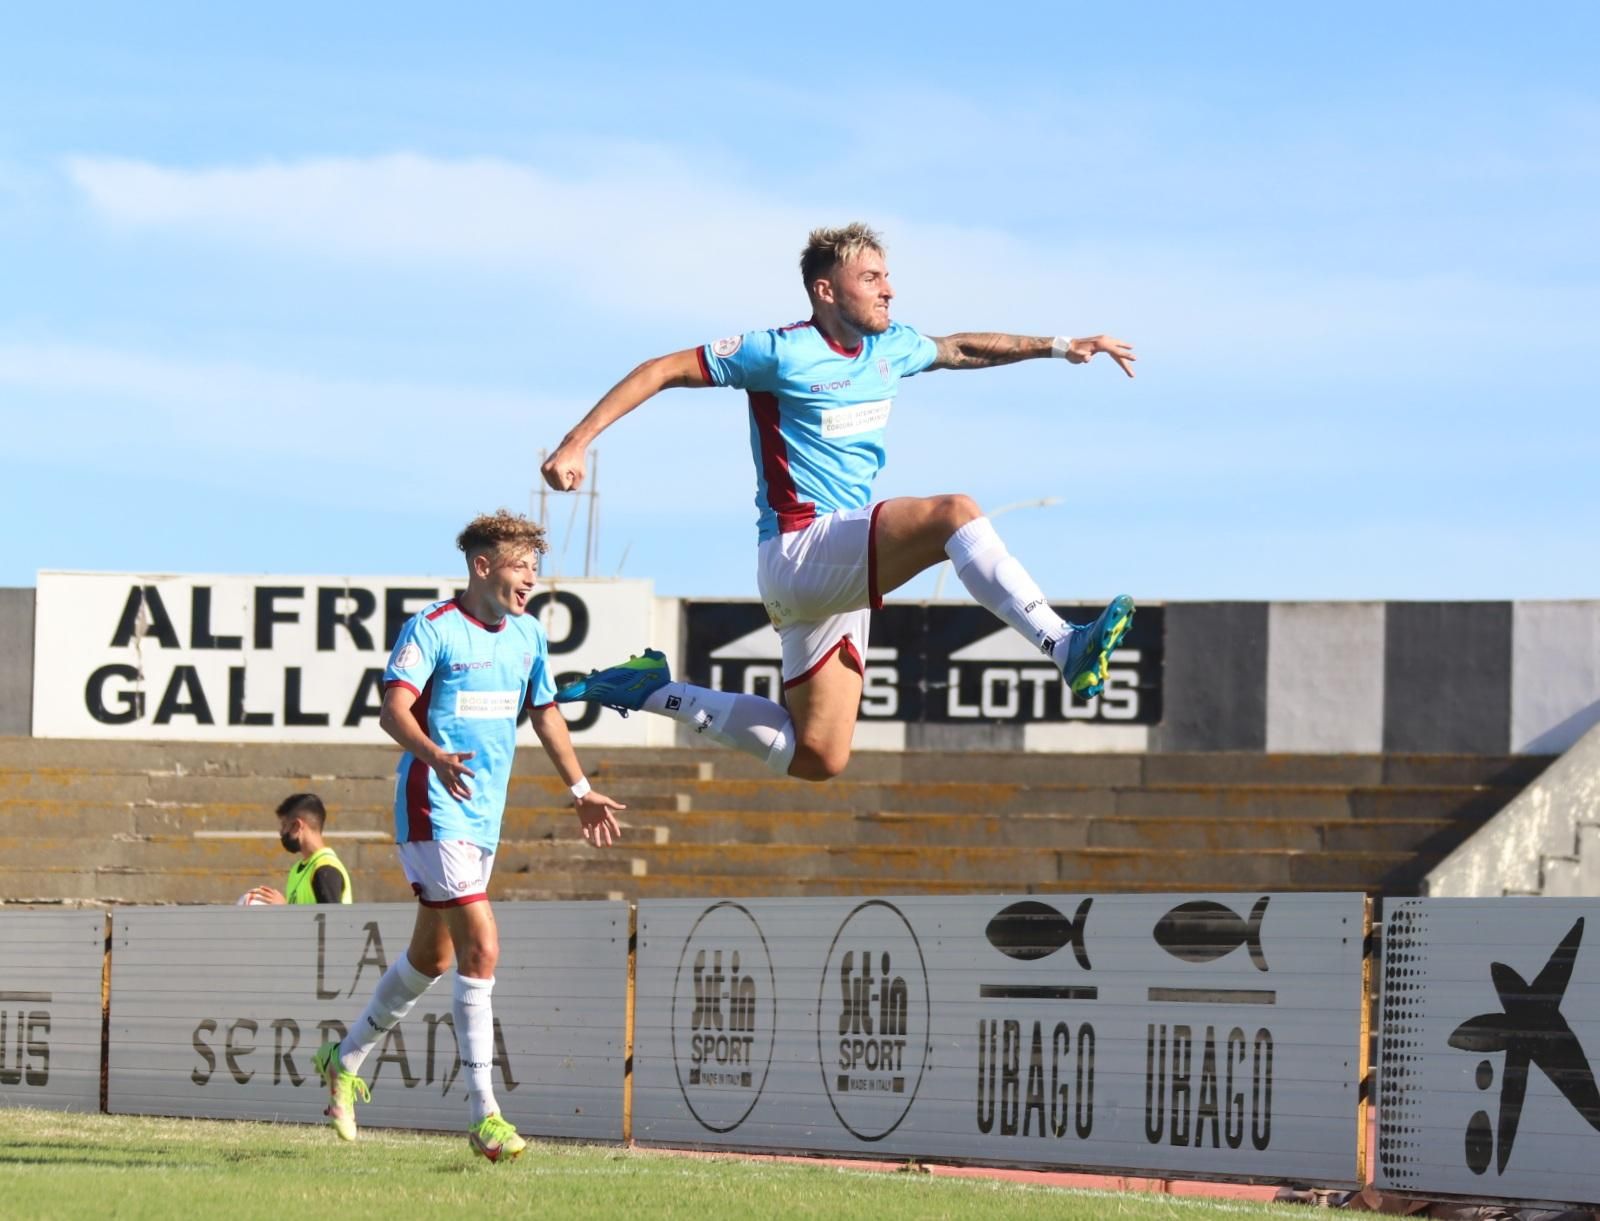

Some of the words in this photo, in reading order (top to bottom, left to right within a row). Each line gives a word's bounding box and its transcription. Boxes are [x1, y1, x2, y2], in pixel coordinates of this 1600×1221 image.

[110, 585, 590, 655] ALFREO
[85, 663, 602, 731] GALLAO
[948, 668, 1139, 719] LOTUS
[313, 912, 388, 1000] LA
[691, 1034, 754, 1066] SPORT
[702, 1073, 718, 1084] MADE
[726, 1074, 740, 1086] ITALY
[839, 1038, 906, 1071] SPORT
[977, 1019, 1095, 1139] UBAGO
[850, 1079, 867, 1090] MADE
[869, 1080, 875, 1090] IN
[876, 1080, 892, 1092] ITALY
[1145, 1024, 1273, 1151] UBAGO
